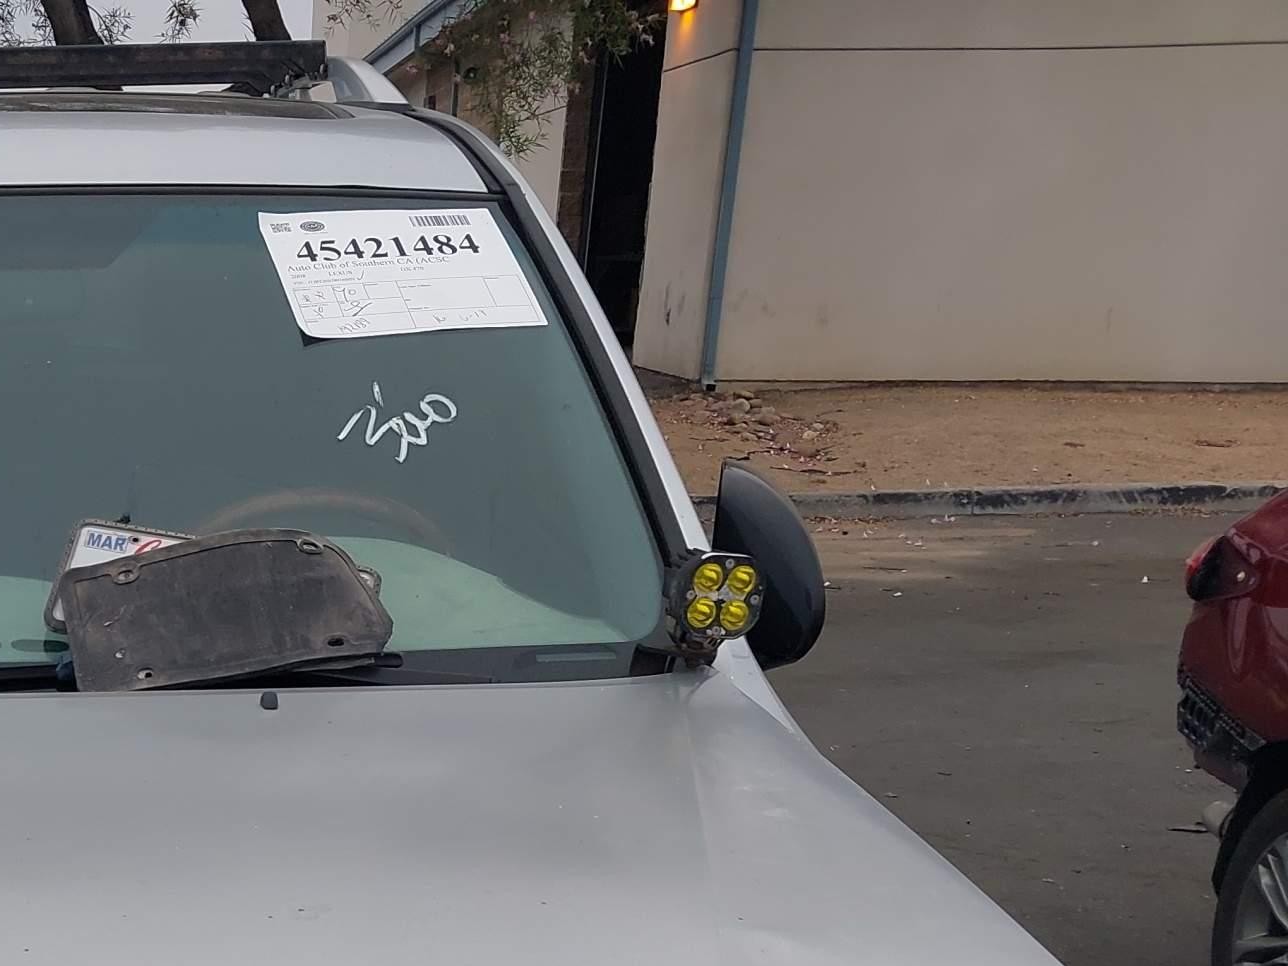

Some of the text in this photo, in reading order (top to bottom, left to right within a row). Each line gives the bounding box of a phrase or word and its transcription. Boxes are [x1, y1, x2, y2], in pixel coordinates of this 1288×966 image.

[297, 233, 480, 262] 45421484
[352, 259, 395, 267] Southern
[415, 256, 450, 264] (ACSC
[87, 532, 127, 552] MAR
